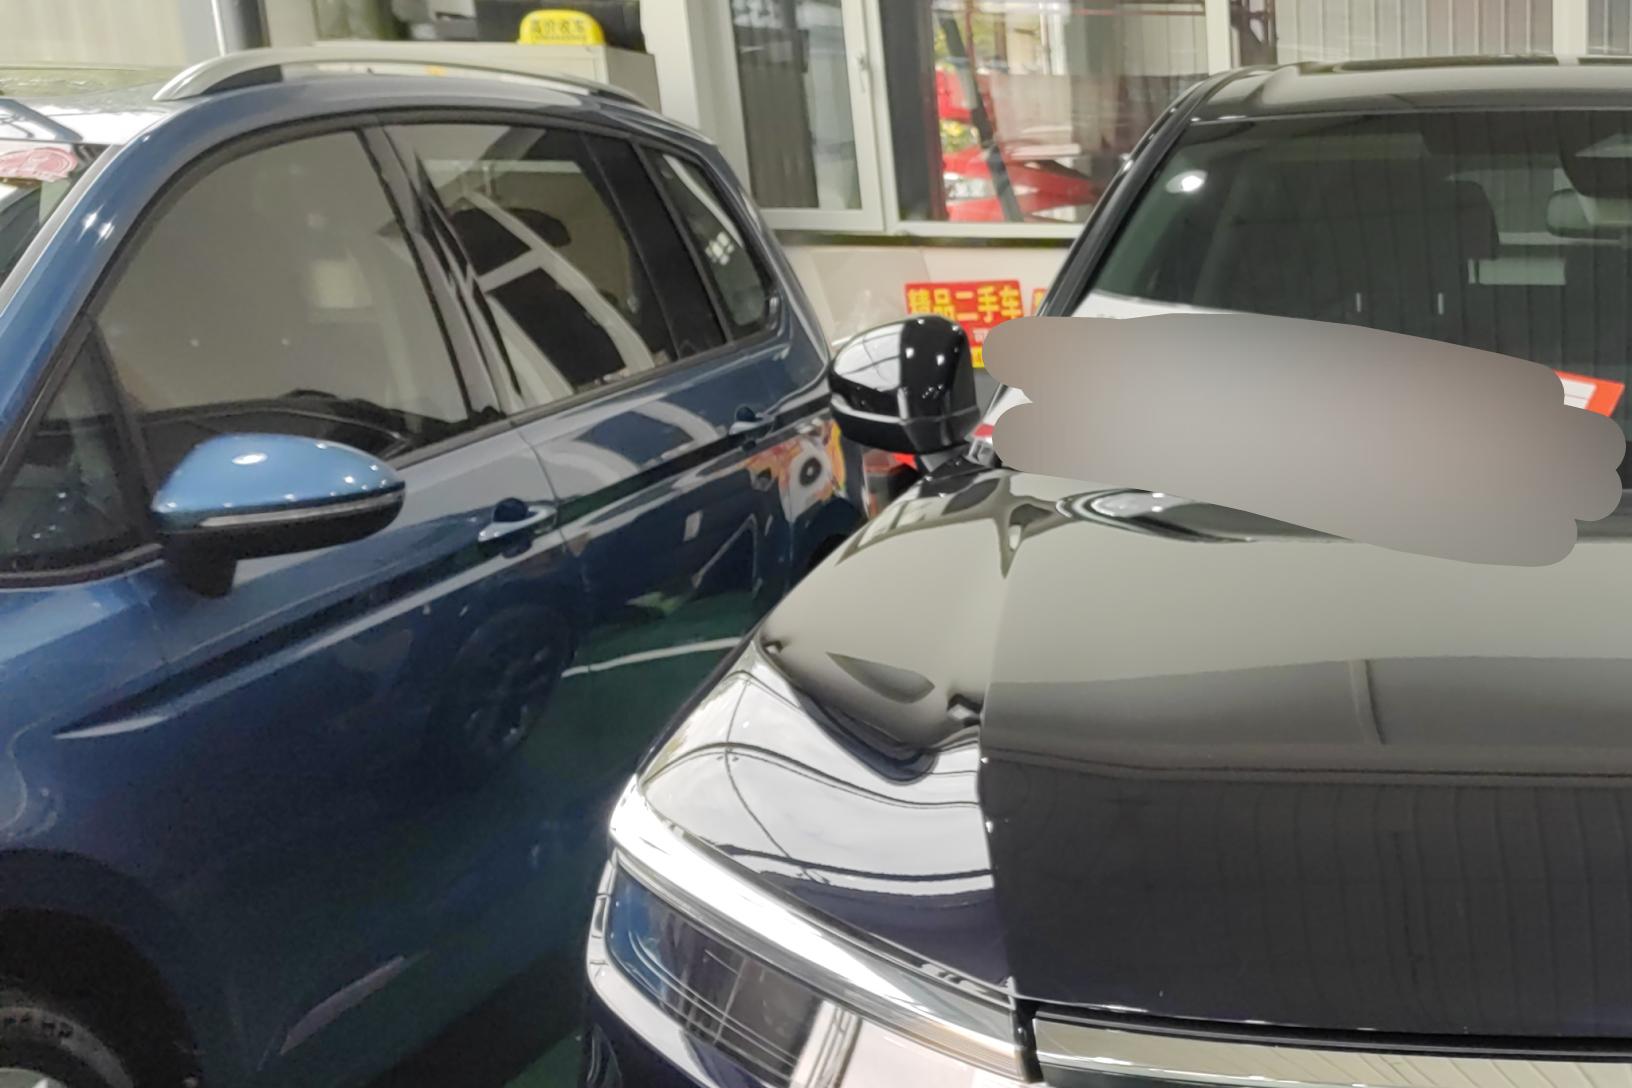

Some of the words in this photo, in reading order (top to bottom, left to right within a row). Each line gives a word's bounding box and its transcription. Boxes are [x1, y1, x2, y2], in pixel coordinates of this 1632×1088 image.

[908, 284, 1022, 323] 精品二手车
